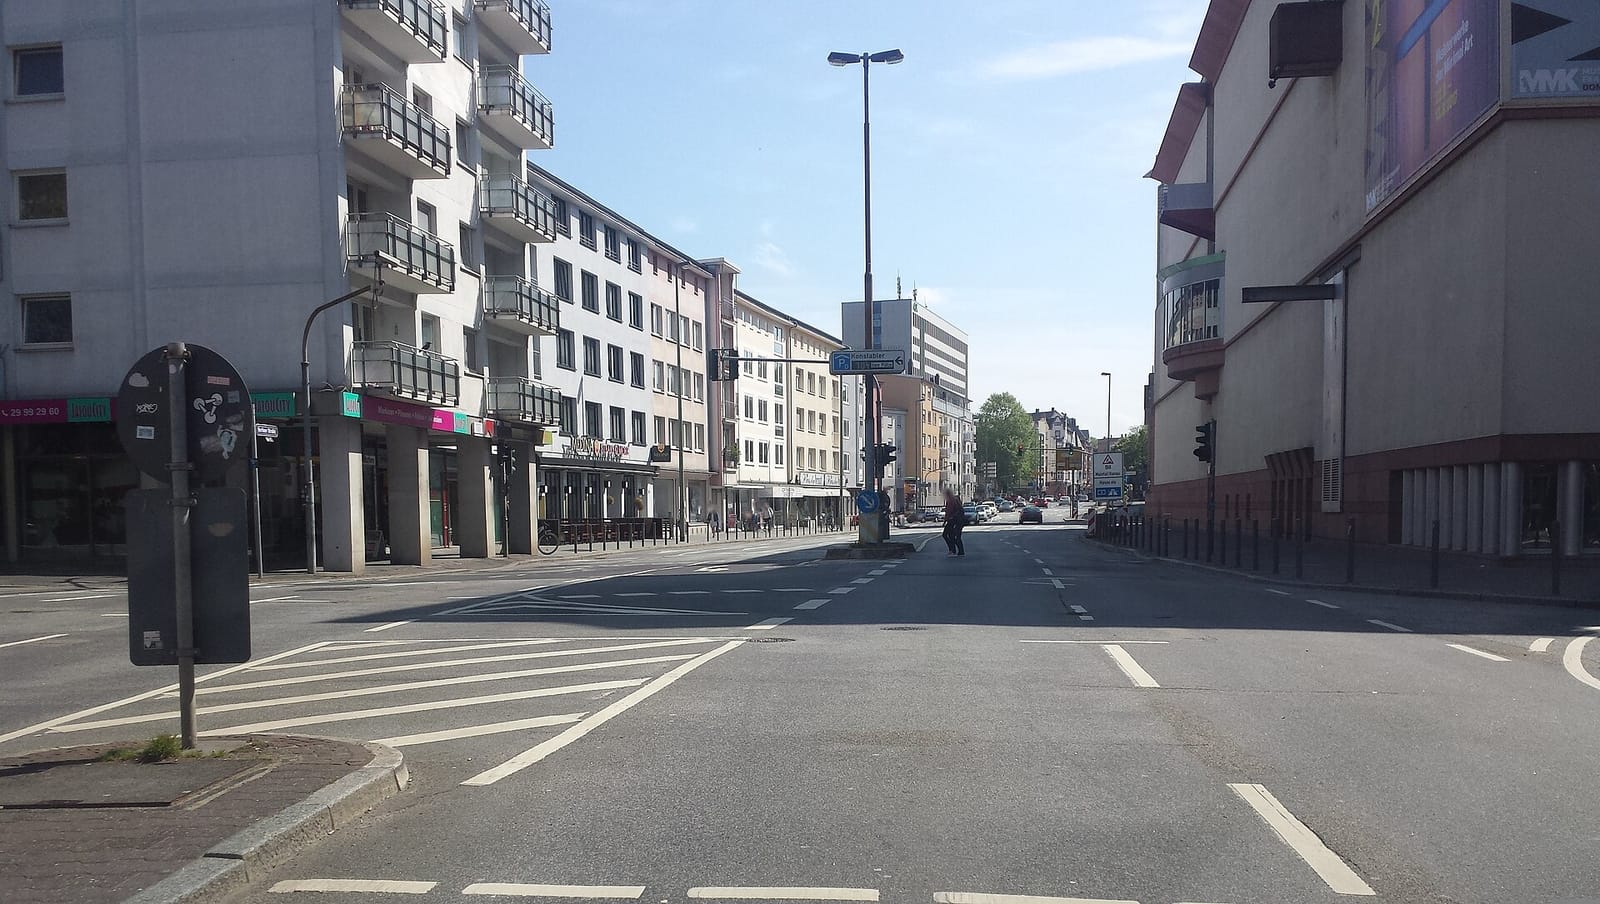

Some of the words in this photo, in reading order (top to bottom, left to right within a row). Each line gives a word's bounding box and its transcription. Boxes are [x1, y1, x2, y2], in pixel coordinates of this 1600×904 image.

[1519, 68, 1580, 93] MMK
[851, 352, 885, 360] Konstabler
[10, 408, 21, 417] 29
[23, 408, 34, 416] 99
[36, 407, 47, 416] 29
[49, 407, 60, 415] 60
